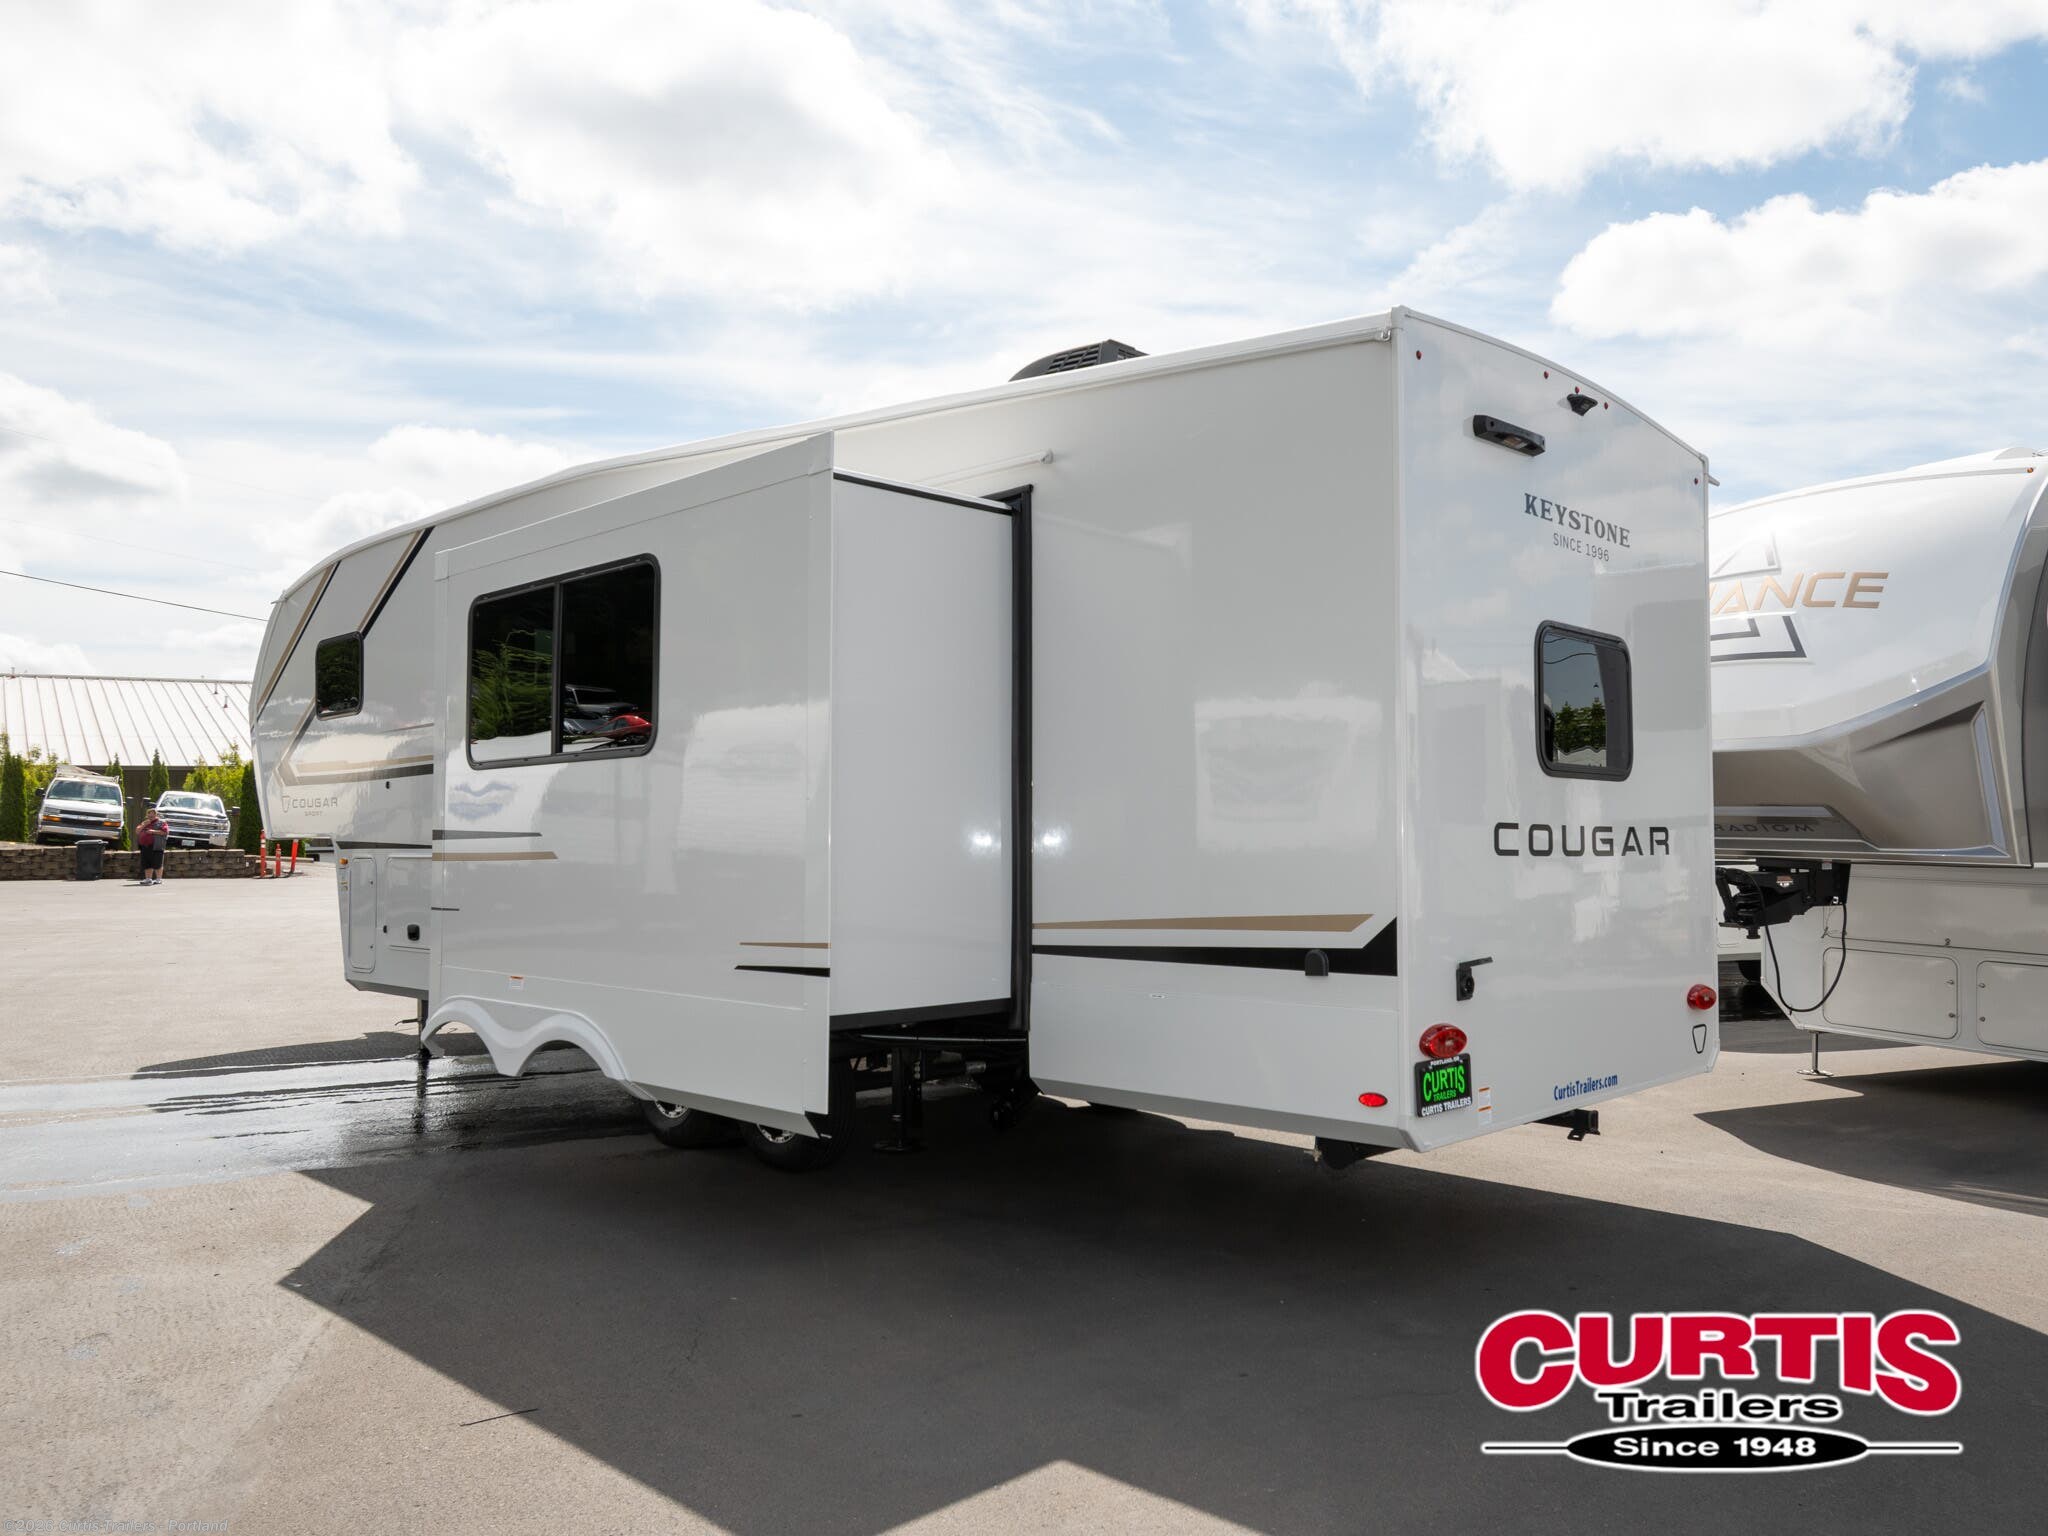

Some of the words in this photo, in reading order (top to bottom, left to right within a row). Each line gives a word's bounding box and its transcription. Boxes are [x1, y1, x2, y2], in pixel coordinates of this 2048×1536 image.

[1524, 493, 1631, 548] KEYSTONE
[1553, 532, 1582, 554] SINCE
[1586, 543, 1610, 562] 1996
[292, 797, 338, 809] COUGAR
[1493, 822, 1670, 857] COUGAR
[1423, 1065, 1466, 1101] CURTIS
[1433, 1089, 1457, 1102] TRAILERS
[1553, 1074, 1618, 1101] CurtisTrailers.com
[1421, 1103, 1443, 1117] CURTIS
[1443, 1096, 1472, 1111] TRAILERS
